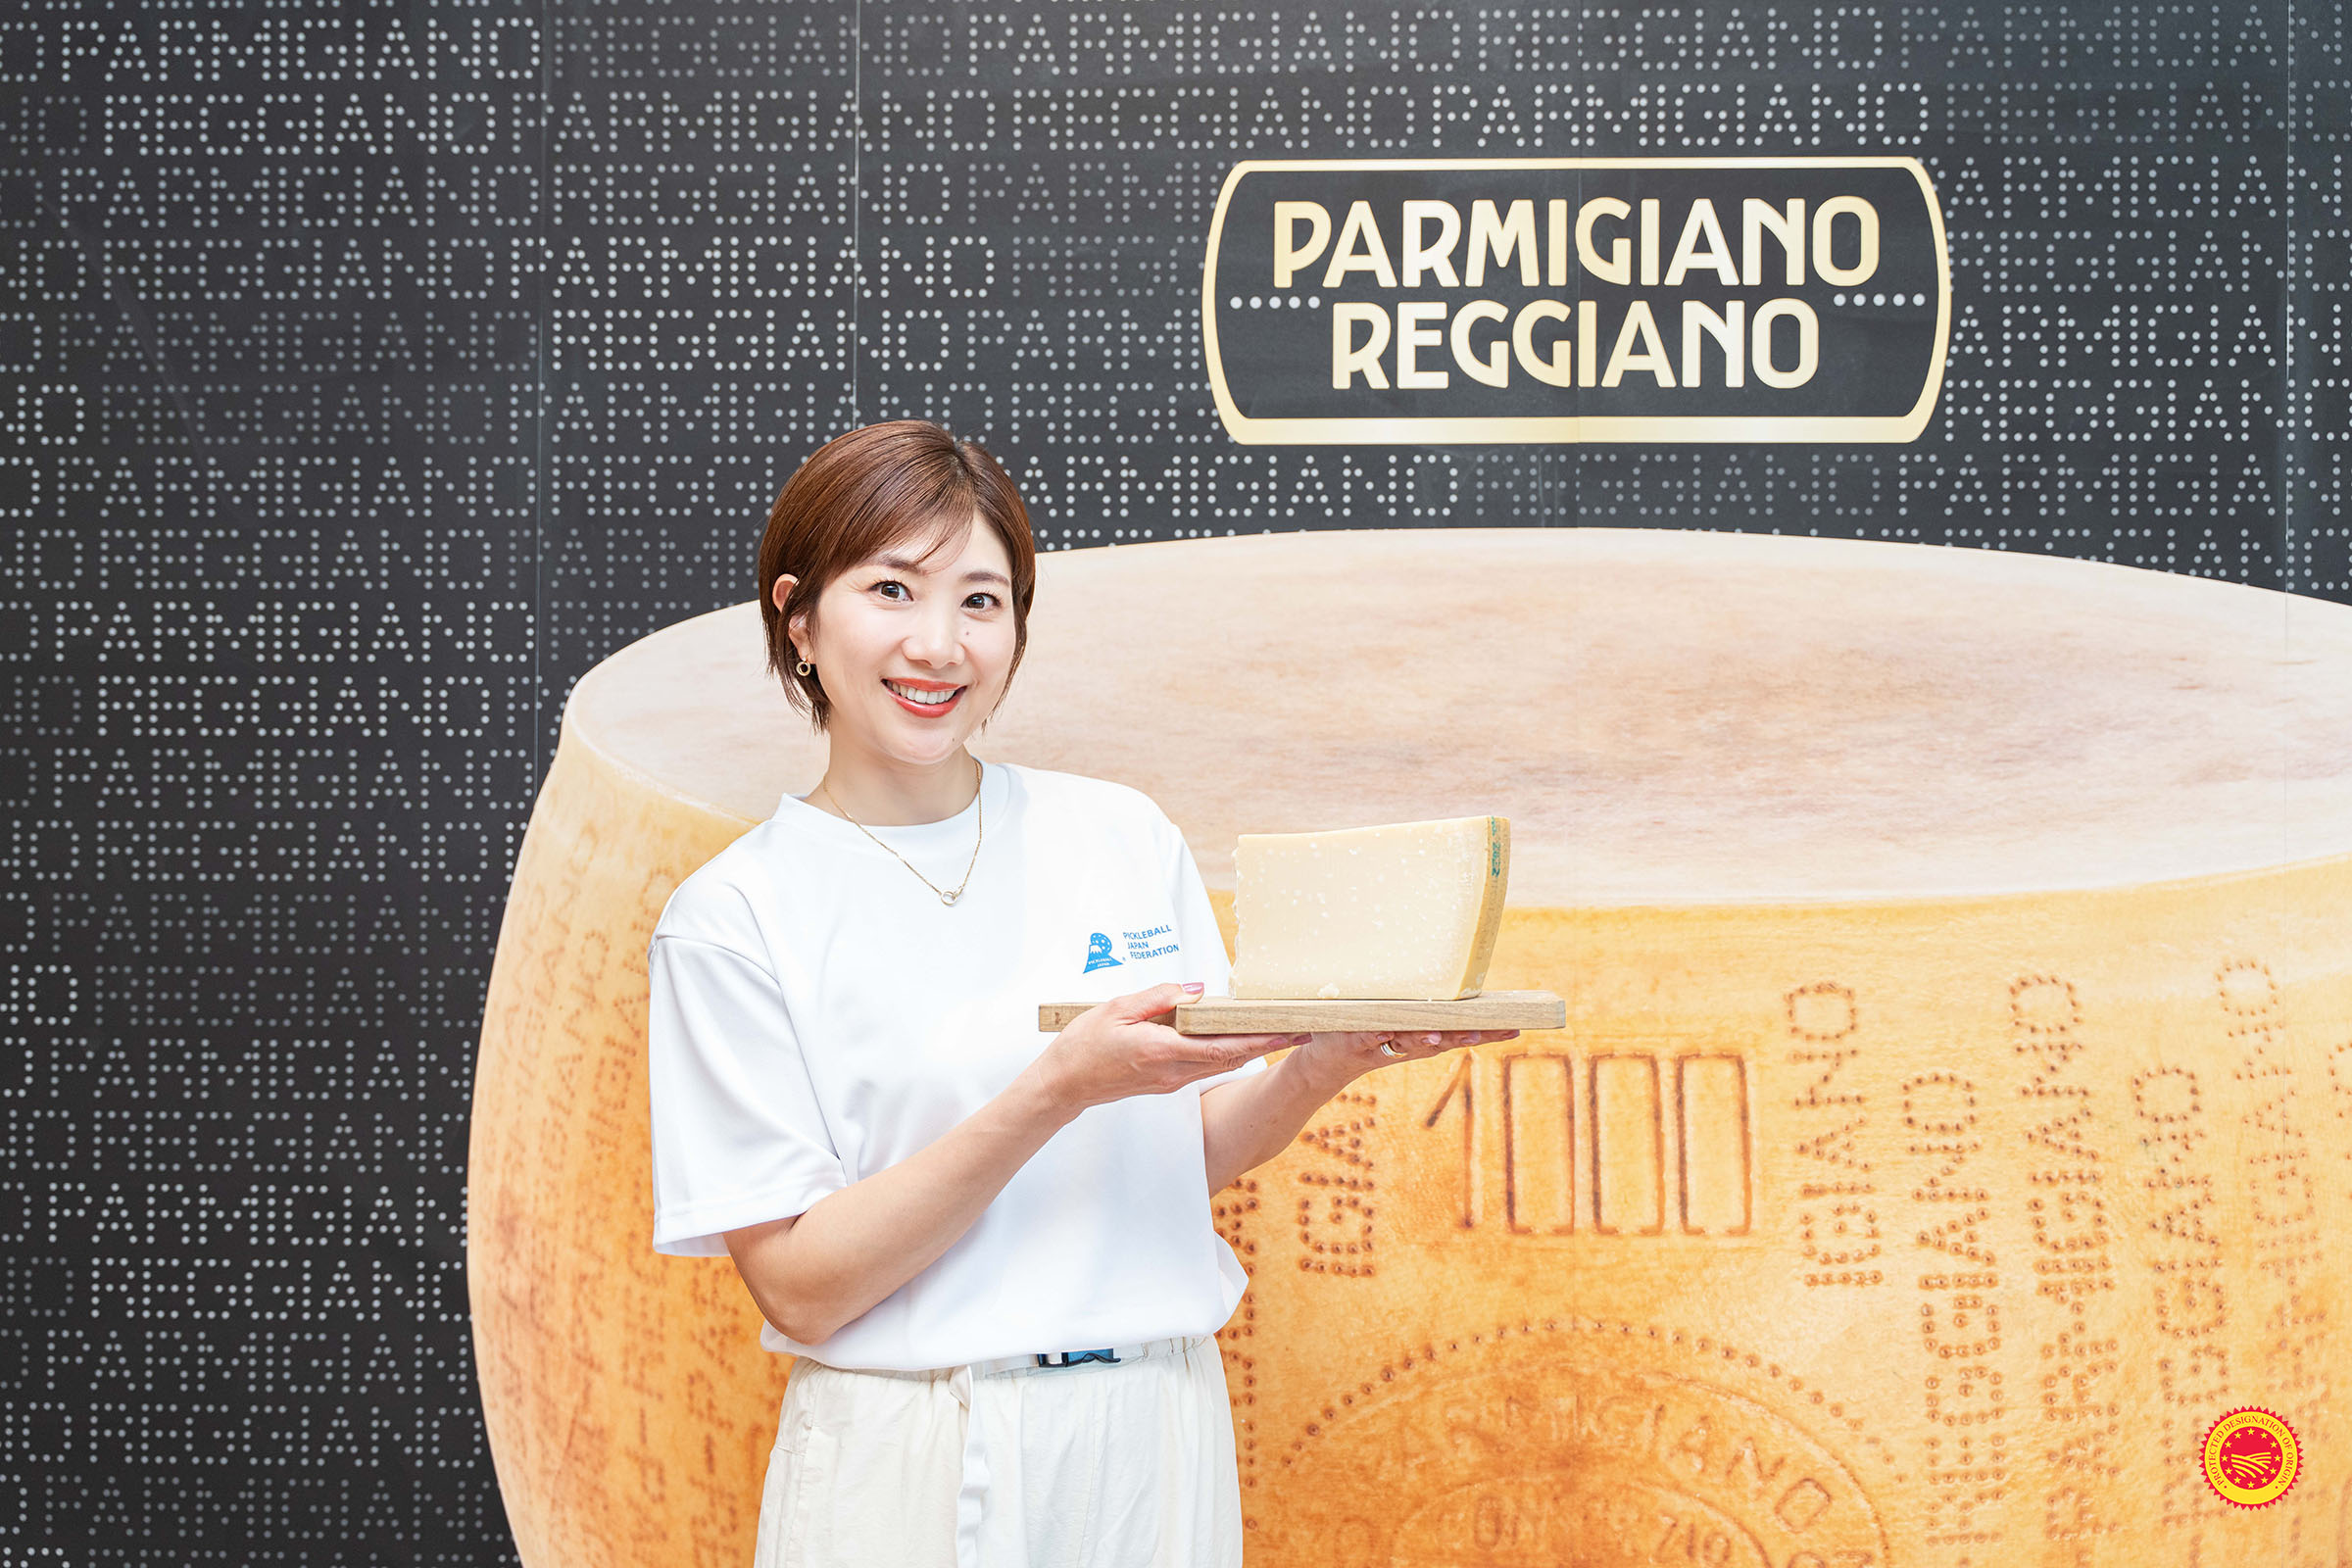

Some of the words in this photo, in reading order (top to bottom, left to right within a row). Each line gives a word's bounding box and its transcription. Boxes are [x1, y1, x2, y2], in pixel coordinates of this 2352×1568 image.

[62, 18, 540, 82] PARMIGIANO
[555, 10, 952, 78] REGGIANO
[969, 10, 1461, 76] PARMIGIANO
[1478, 7, 1883, 72] REGGIANO
[104, 93, 496, 156] REGGIANO
[513, 89, 996, 154] PARMIGIANO
[1013, 86, 1415, 151] REGGIANO
[1433, 82, 1929, 147] PARMIGIANO
[1946, 79, 2351, 145] REGGIANO
[60, 165, 539, 228] PARMIGIANO
[554, 163, 951, 227] REGGIANO
[103, 238, 494, 301] REGGIANO
[511, 236, 995, 299] PARMIGIANO
[1274, 196, 1880, 287] PARMIGIANO
[1946, 229, 2352, 293] REGGIANO
[59, 311, 537, 372] PARMIGIANO
[553, 310, 950, 371] REGGIANO
[1333, 298, 1819, 389] REGGIANO
[101, 383, 493, 445] REGGIANO
[1945, 378, 2352, 442] REGGIANO
[57, 456, 536, 517] PARMIGIANO
[991, 455, 1458, 517] ARMIGIANO
[1476, 454, 1881, 516] REGGIANO
[100, 529, 491, 590] REGGIANO
[55, 601, 535, 662] PARMIGIANO
[98, 675, 490, 737] REGGIANO
[54, 748, 533, 809] PARMIGIANO
[96, 820, 488, 883] REGGIANO
[1122, 924, 1172, 940] PICKLEBALL
[1130, 944, 1180, 959] FEDERATION
[94, 965, 486, 1028] REGGIANO
[1425, 1051, 1752, 1239] 1000
[89, 1402, 482, 1468] REGGIANO
